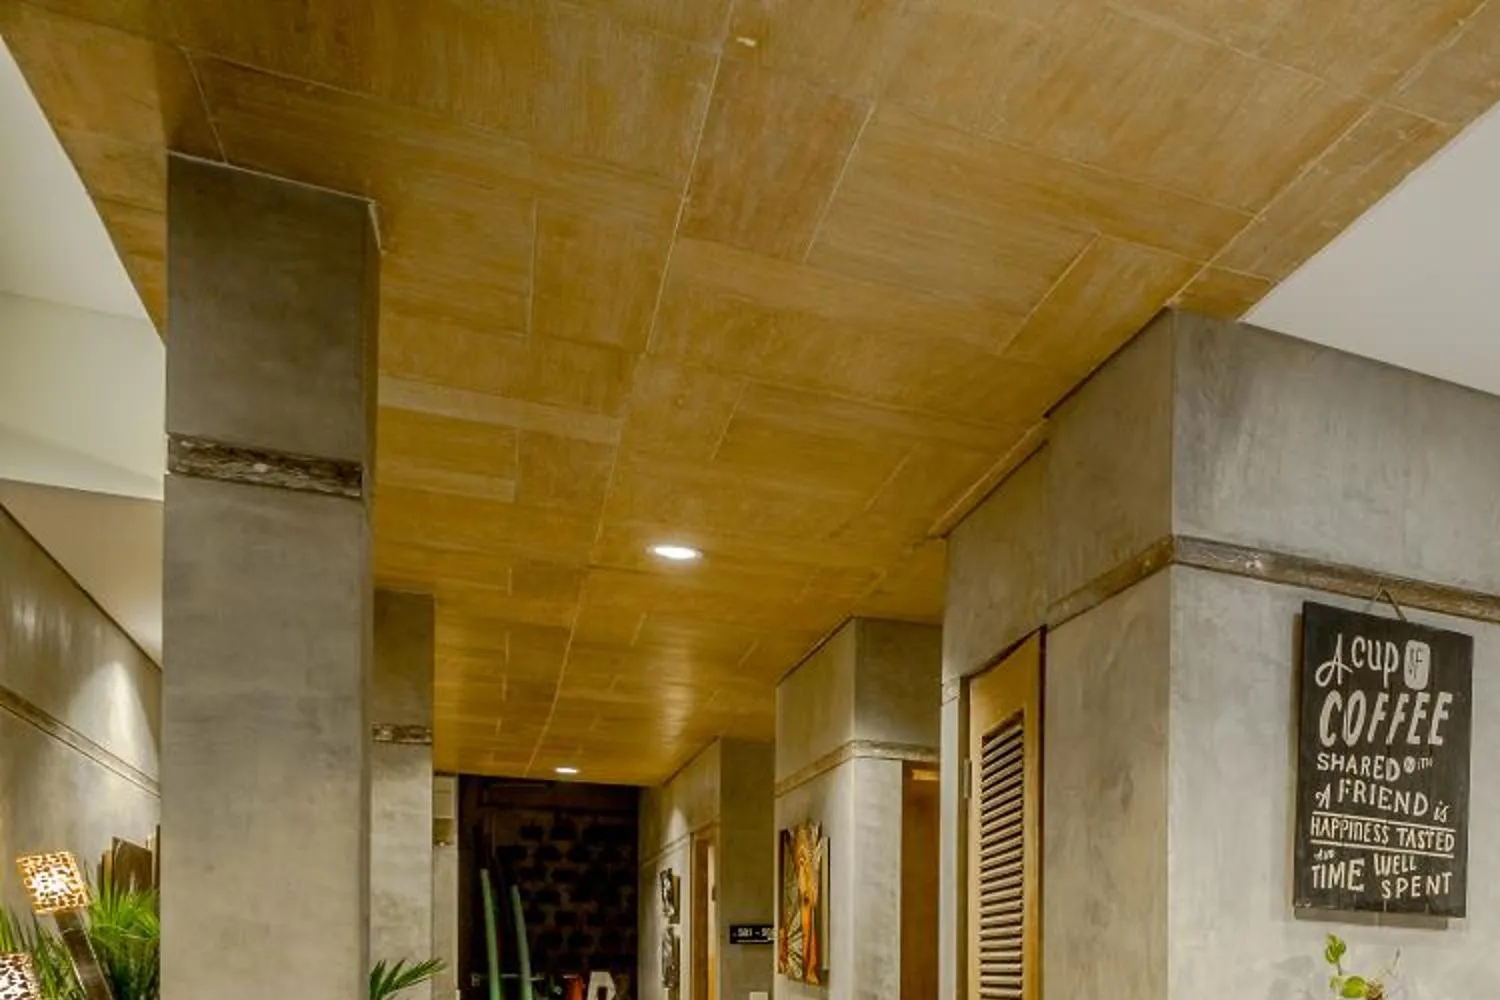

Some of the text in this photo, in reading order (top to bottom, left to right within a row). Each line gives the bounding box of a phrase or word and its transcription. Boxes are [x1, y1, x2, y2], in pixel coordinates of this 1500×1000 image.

[1319, 689, 1454, 747] COFFEE
[1317, 752, 1402, 782] SHARED
[1315, 783, 1331, 810] A
[1337, 778, 1429, 816] FRIEND
[1396, 828, 1456, 853] TASTED
[1312, 853, 1417, 892] TIME WELL
[1381, 871, 1453, 900] SPENT
